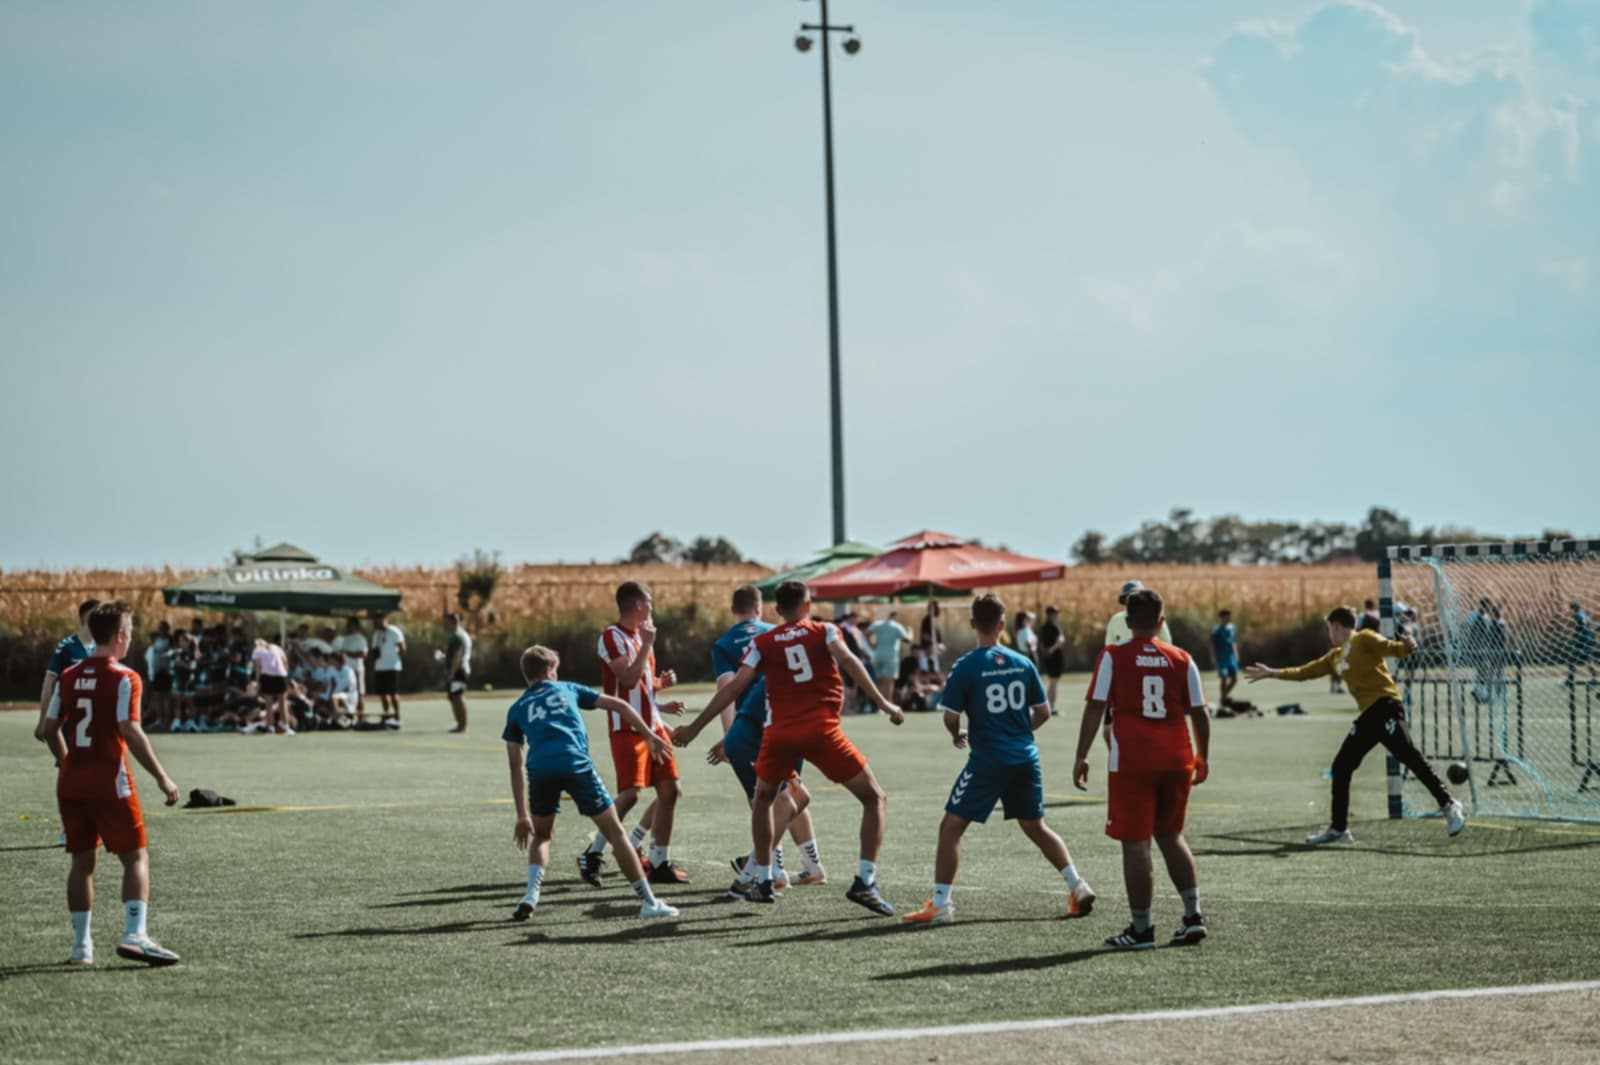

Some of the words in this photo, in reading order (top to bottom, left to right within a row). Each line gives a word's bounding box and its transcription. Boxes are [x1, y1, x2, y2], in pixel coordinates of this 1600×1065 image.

[784, 644, 813, 683] 9
[527, 693, 569, 723] 49
[985, 680, 1026, 713] 80
[1142, 675, 1167, 719] 8
[76, 698, 92, 747] 2
